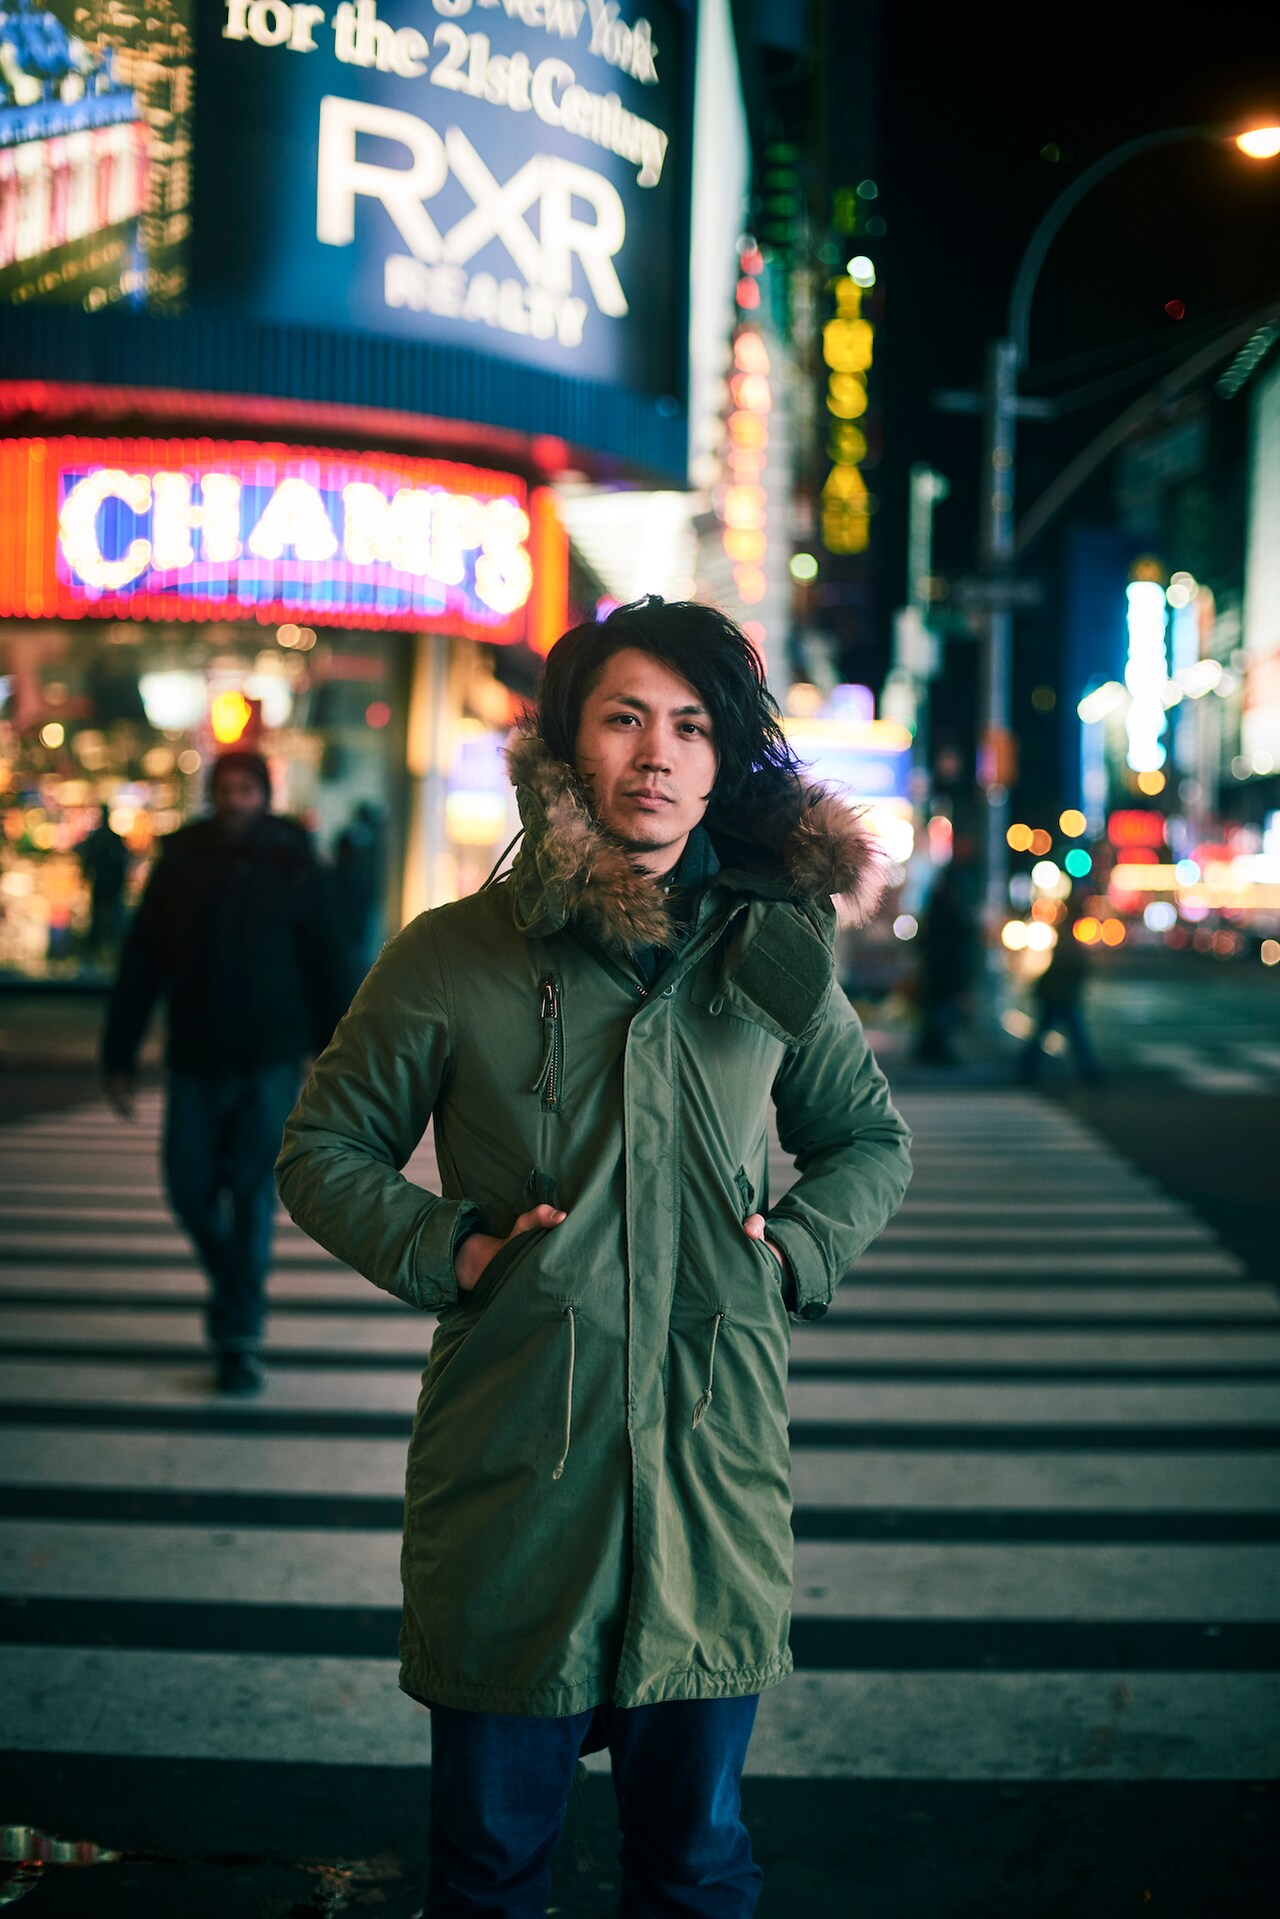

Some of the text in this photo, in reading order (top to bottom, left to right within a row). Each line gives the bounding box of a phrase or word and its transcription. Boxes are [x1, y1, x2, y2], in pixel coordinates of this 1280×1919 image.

[331, 0, 430, 78] the
[430, 21, 533, 112] 21st
[531, 57, 669, 188] Century
[317, 95, 628, 318] RXR
[384, 253, 589, 348] REALTY
[59, 468, 533, 614] CHAMPS
